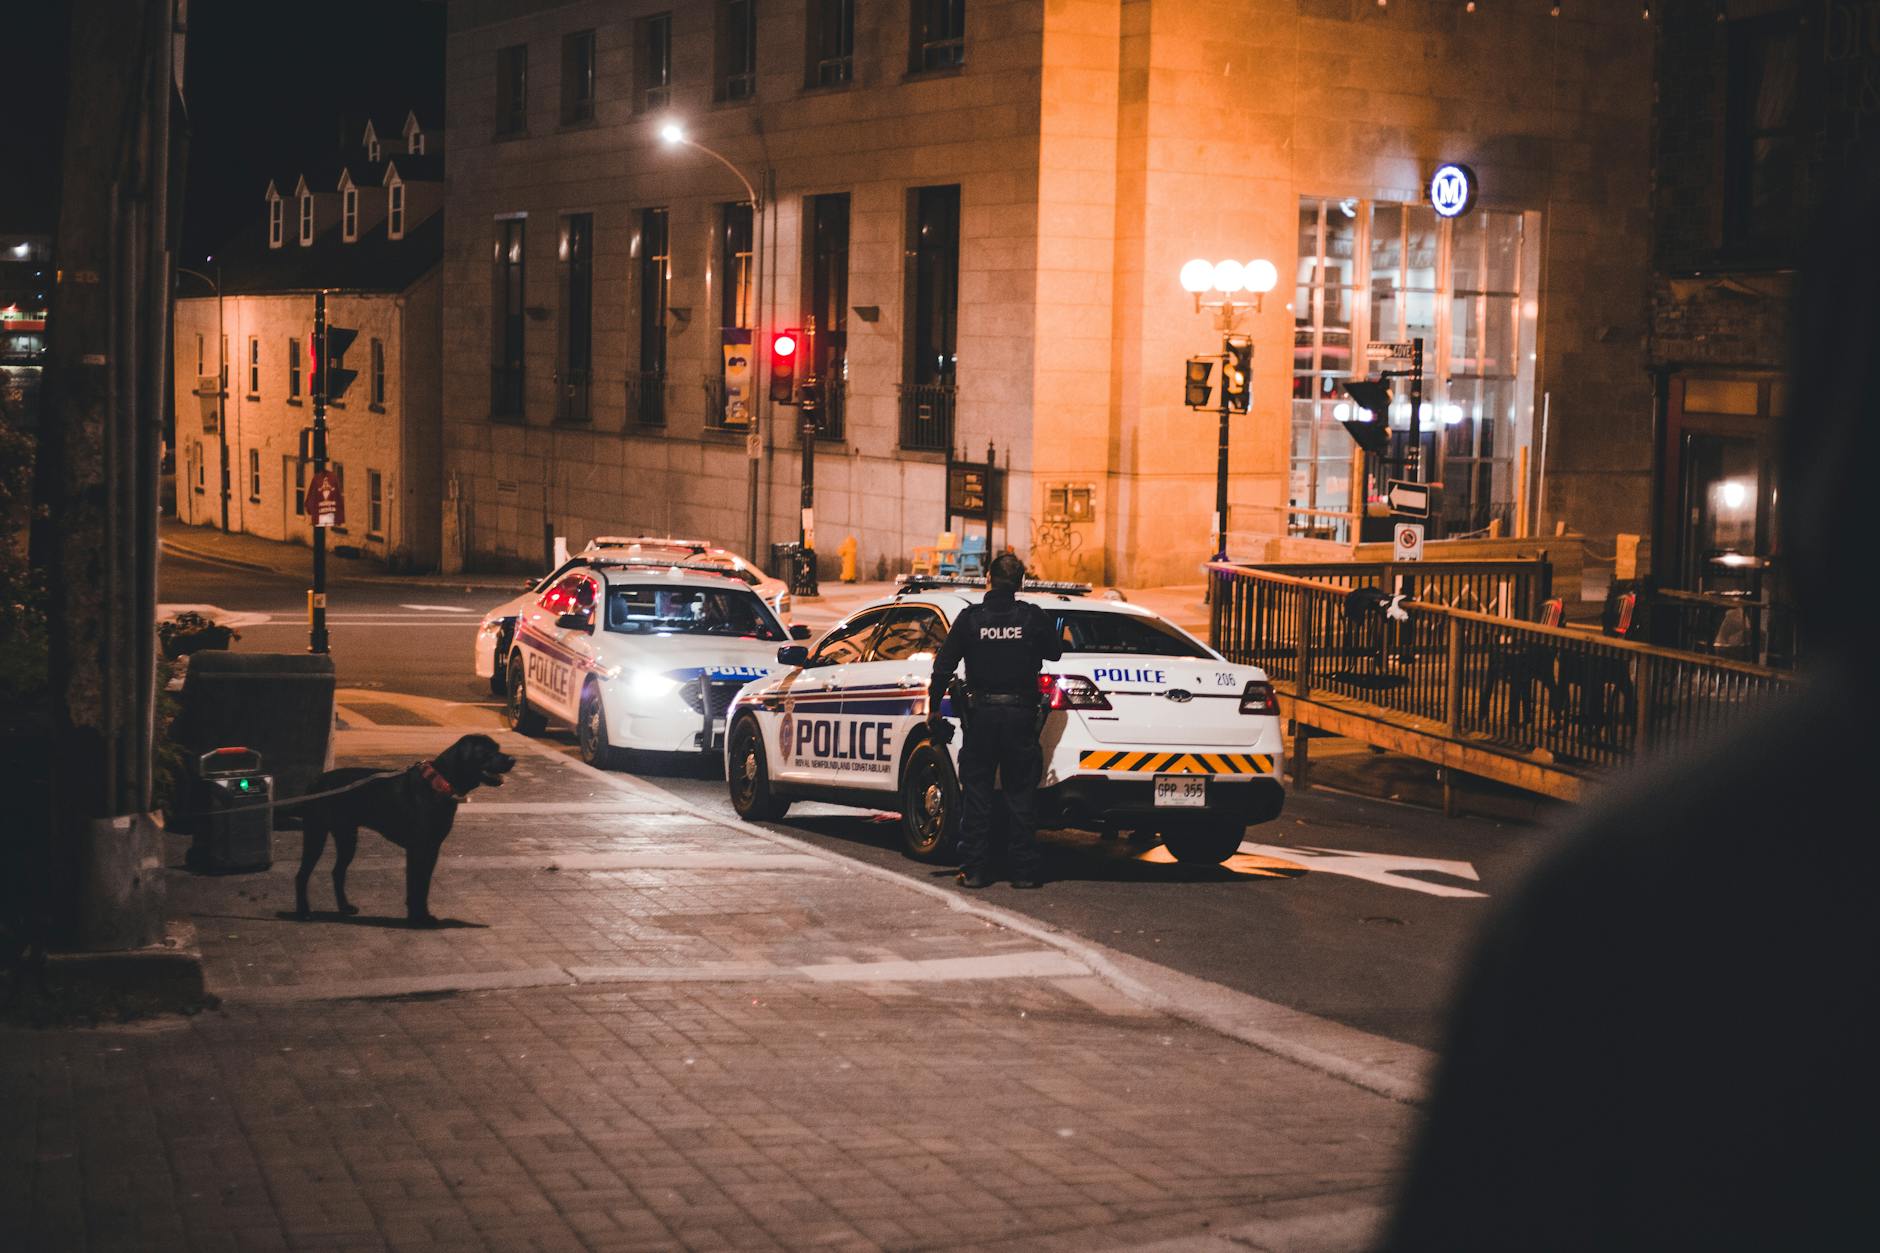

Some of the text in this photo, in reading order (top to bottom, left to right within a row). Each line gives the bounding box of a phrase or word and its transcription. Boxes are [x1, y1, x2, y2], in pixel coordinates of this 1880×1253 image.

[980, 627, 1022, 640] POLICE
[528, 652, 568, 697] POLICE
[704, 666, 769, 676] POLIC
[1093, 669, 1167, 684] POLICE
[1215, 672, 1236, 687] 206
[796, 719, 893, 761] POLICE
[795, 758, 891, 774] ROYAL NEWFOUNDLAND CONSTABULARY
[1158, 783, 1203, 798] GPP 355
